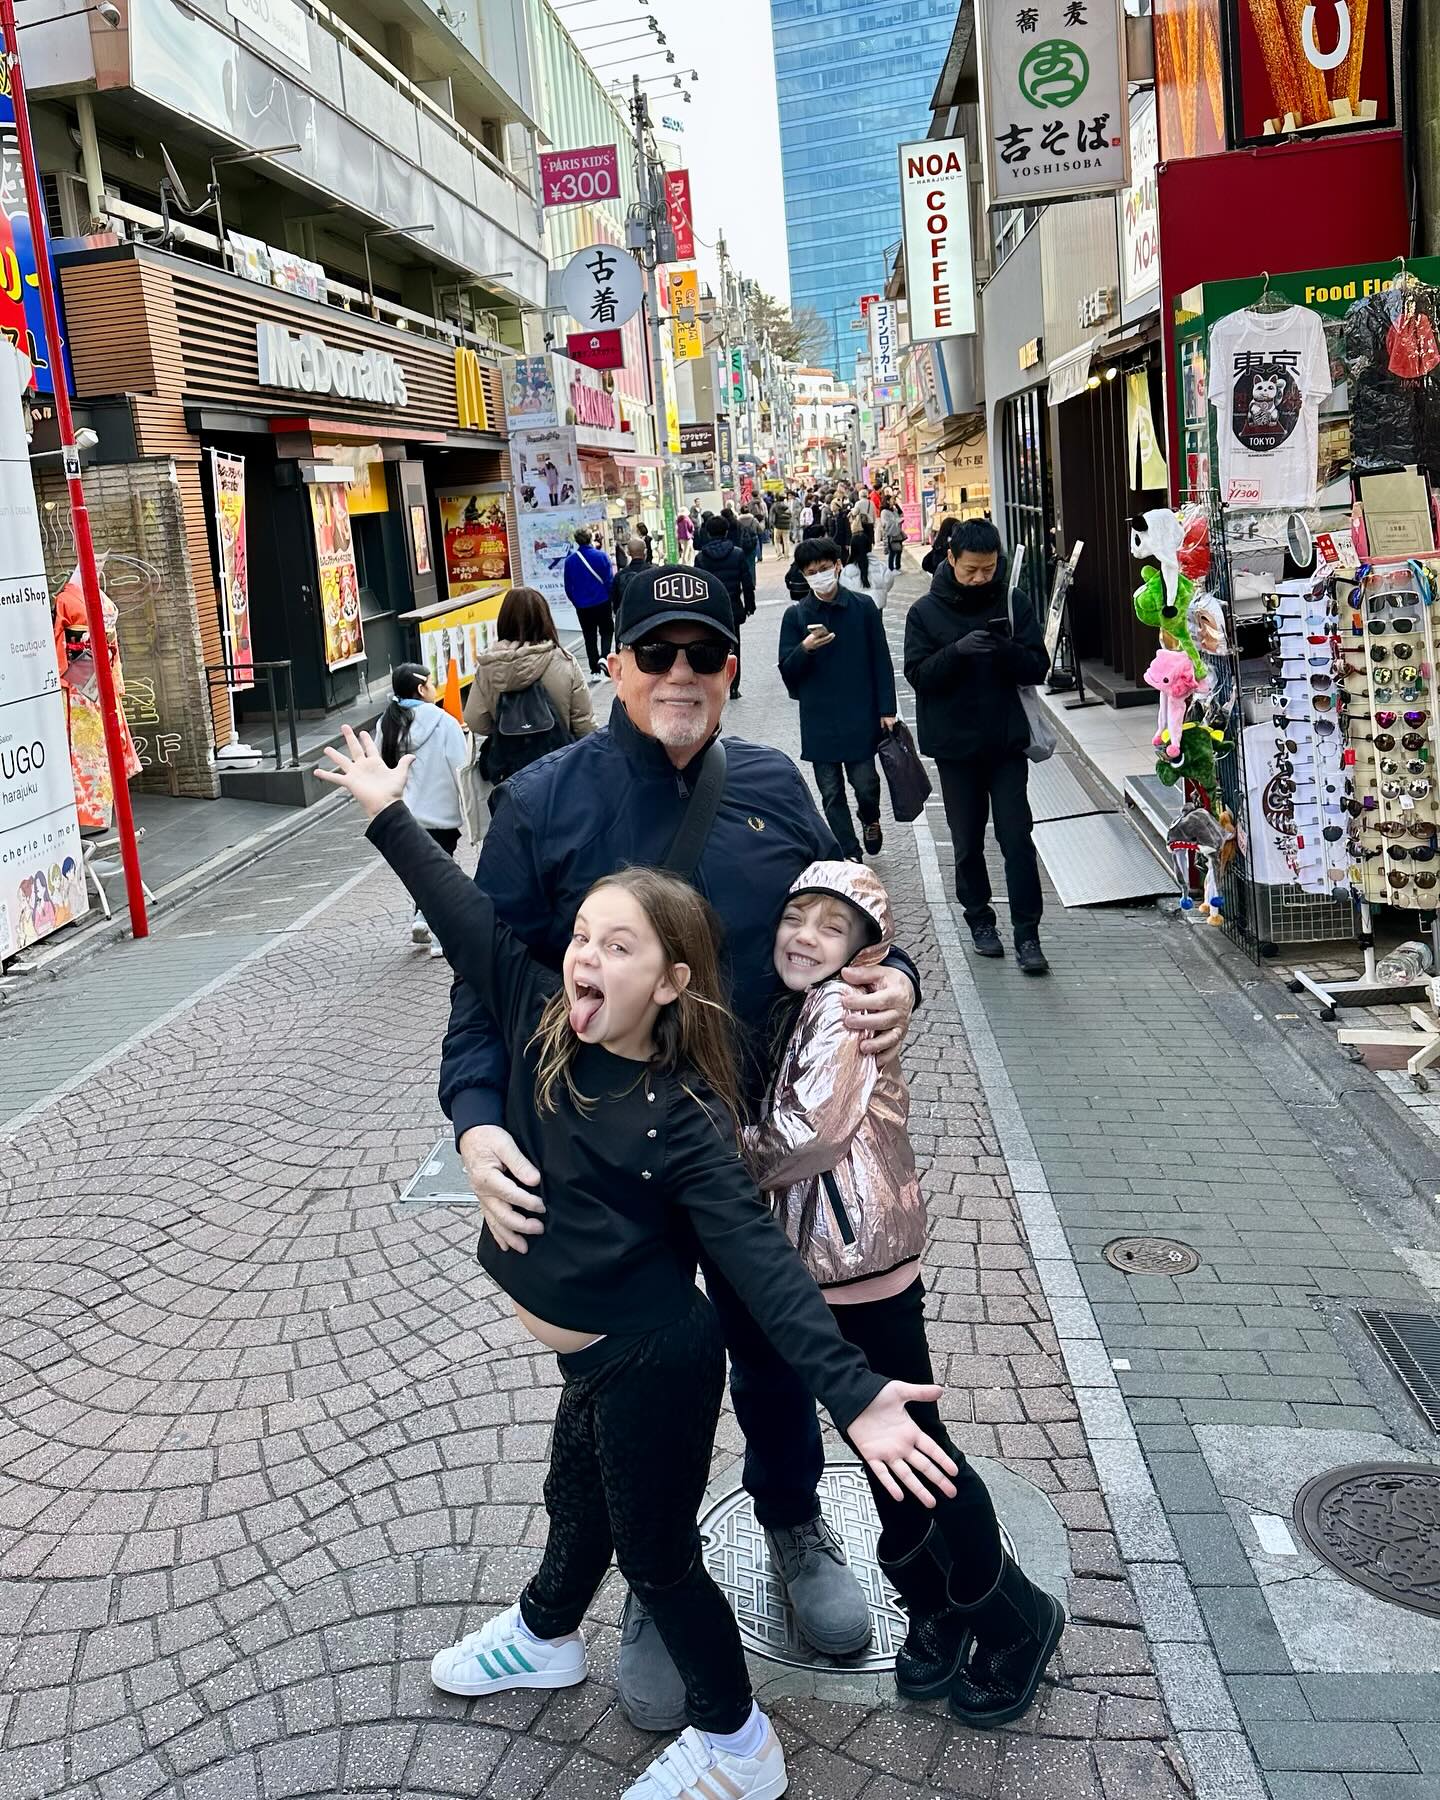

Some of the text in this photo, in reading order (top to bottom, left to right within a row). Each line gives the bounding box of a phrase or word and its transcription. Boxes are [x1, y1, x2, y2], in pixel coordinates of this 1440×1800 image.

[1016, 1, 1089, 34] 蕎麦
[994, 113, 1110, 164] 吉そば
[549, 154, 610, 172] PARIS KID'S
[907, 151, 962, 179] NOA
[1012, 158, 1102, 178] YOSHISOBA
[550, 170, 611, 201] ¥300
[926, 190, 952, 328] COFFEE
[586, 250, 618, 323] 古着
[1305, 282, 1356, 304] Food
[877, 306, 890, 373] コインロッカー
[1233, 349, 1302, 378] 東京
[1249, 437, 1276, 447] TOKYO
[0, 587, 46, 606] ental Shop
[659, 576, 704, 598] DEUS
[2, 782, 38, 805] harajuku
[2, 840, 38, 863] cherie
[57, 823, 76, 838] mer
